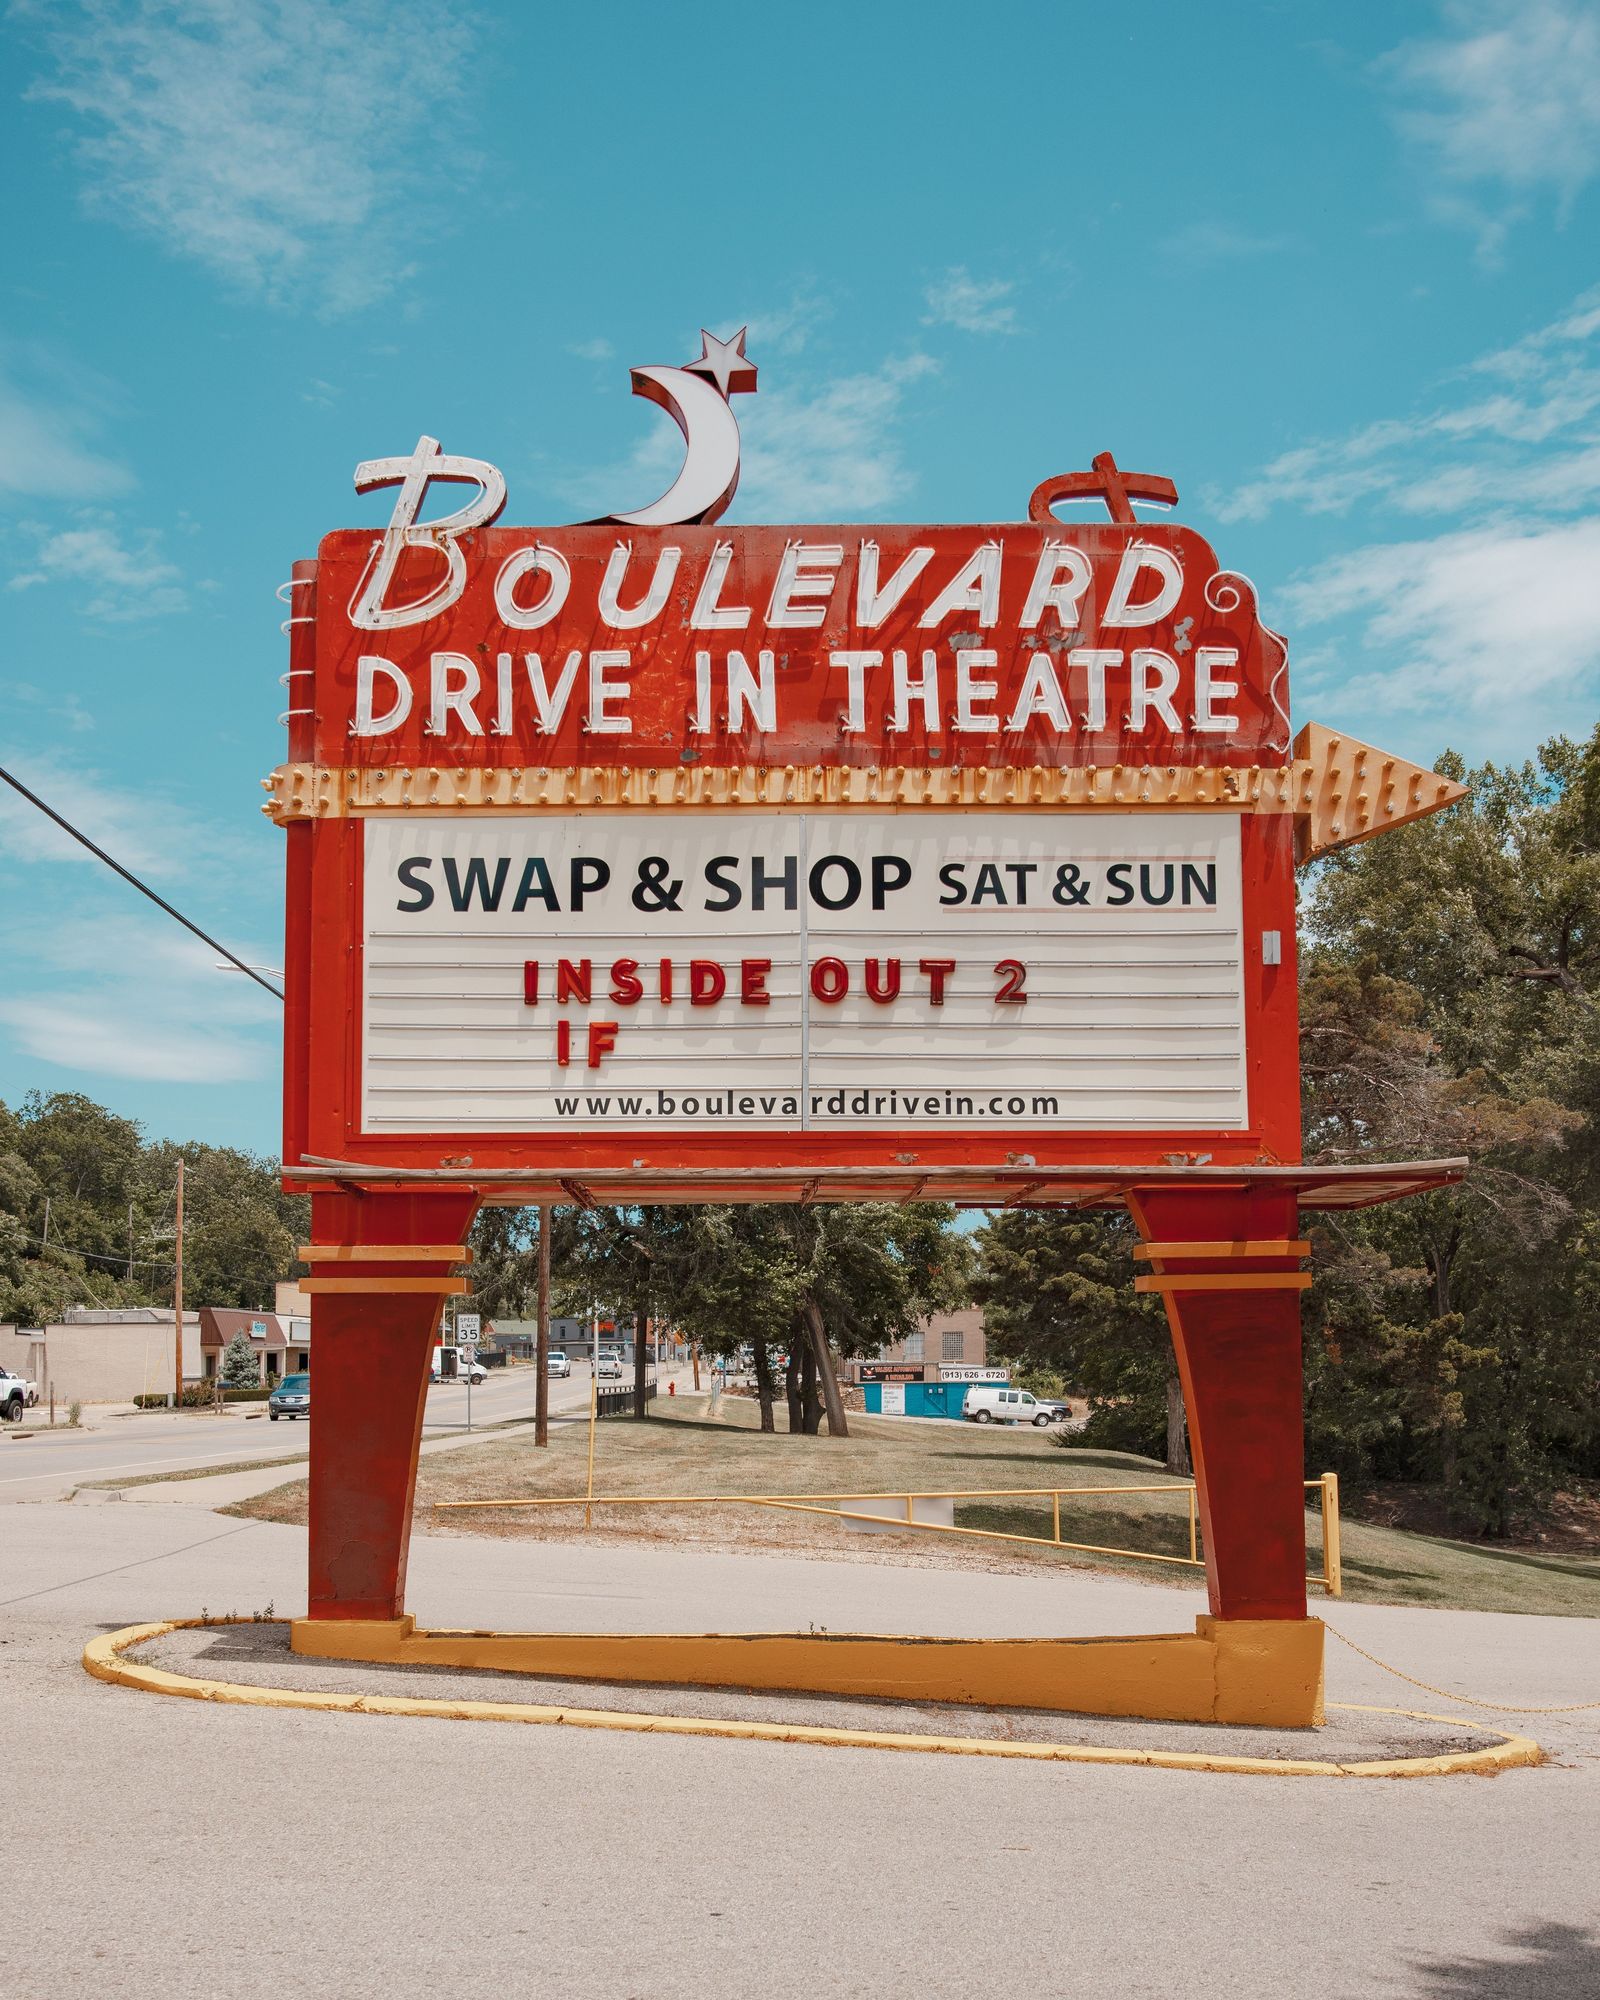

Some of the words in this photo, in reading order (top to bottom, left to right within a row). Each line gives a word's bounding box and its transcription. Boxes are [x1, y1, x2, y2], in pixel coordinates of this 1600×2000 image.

[349, 436, 1186, 632] BOULEVARD
[351, 651, 633, 738] DRIVE
[693, 650, 777, 735] IN
[829, 646, 1241, 735] THEATRE
[396, 856, 612, 913] SWAP
[631, 856, 684, 913] &
[703, 855, 912, 912] SHOP
[939, 863, 1037, 905] SAT
[1052, 863, 1091, 905] &
[1106, 863, 1217, 905] SUN
[523, 957, 772, 1006] INSIDE
[809, 956, 956, 1006] OUT
[994, 959, 1028, 1005] 2
[556, 1020, 619, 1068] IF
[554, 1090, 1060, 1117] www.boulevarddrivein.com
[460, 1329, 478, 1340] 35
[942, 1371, 962, 1380] (913)
[964, 1371, 979, 1379] 626
[985, 1371, 1006, 1379] 6720
